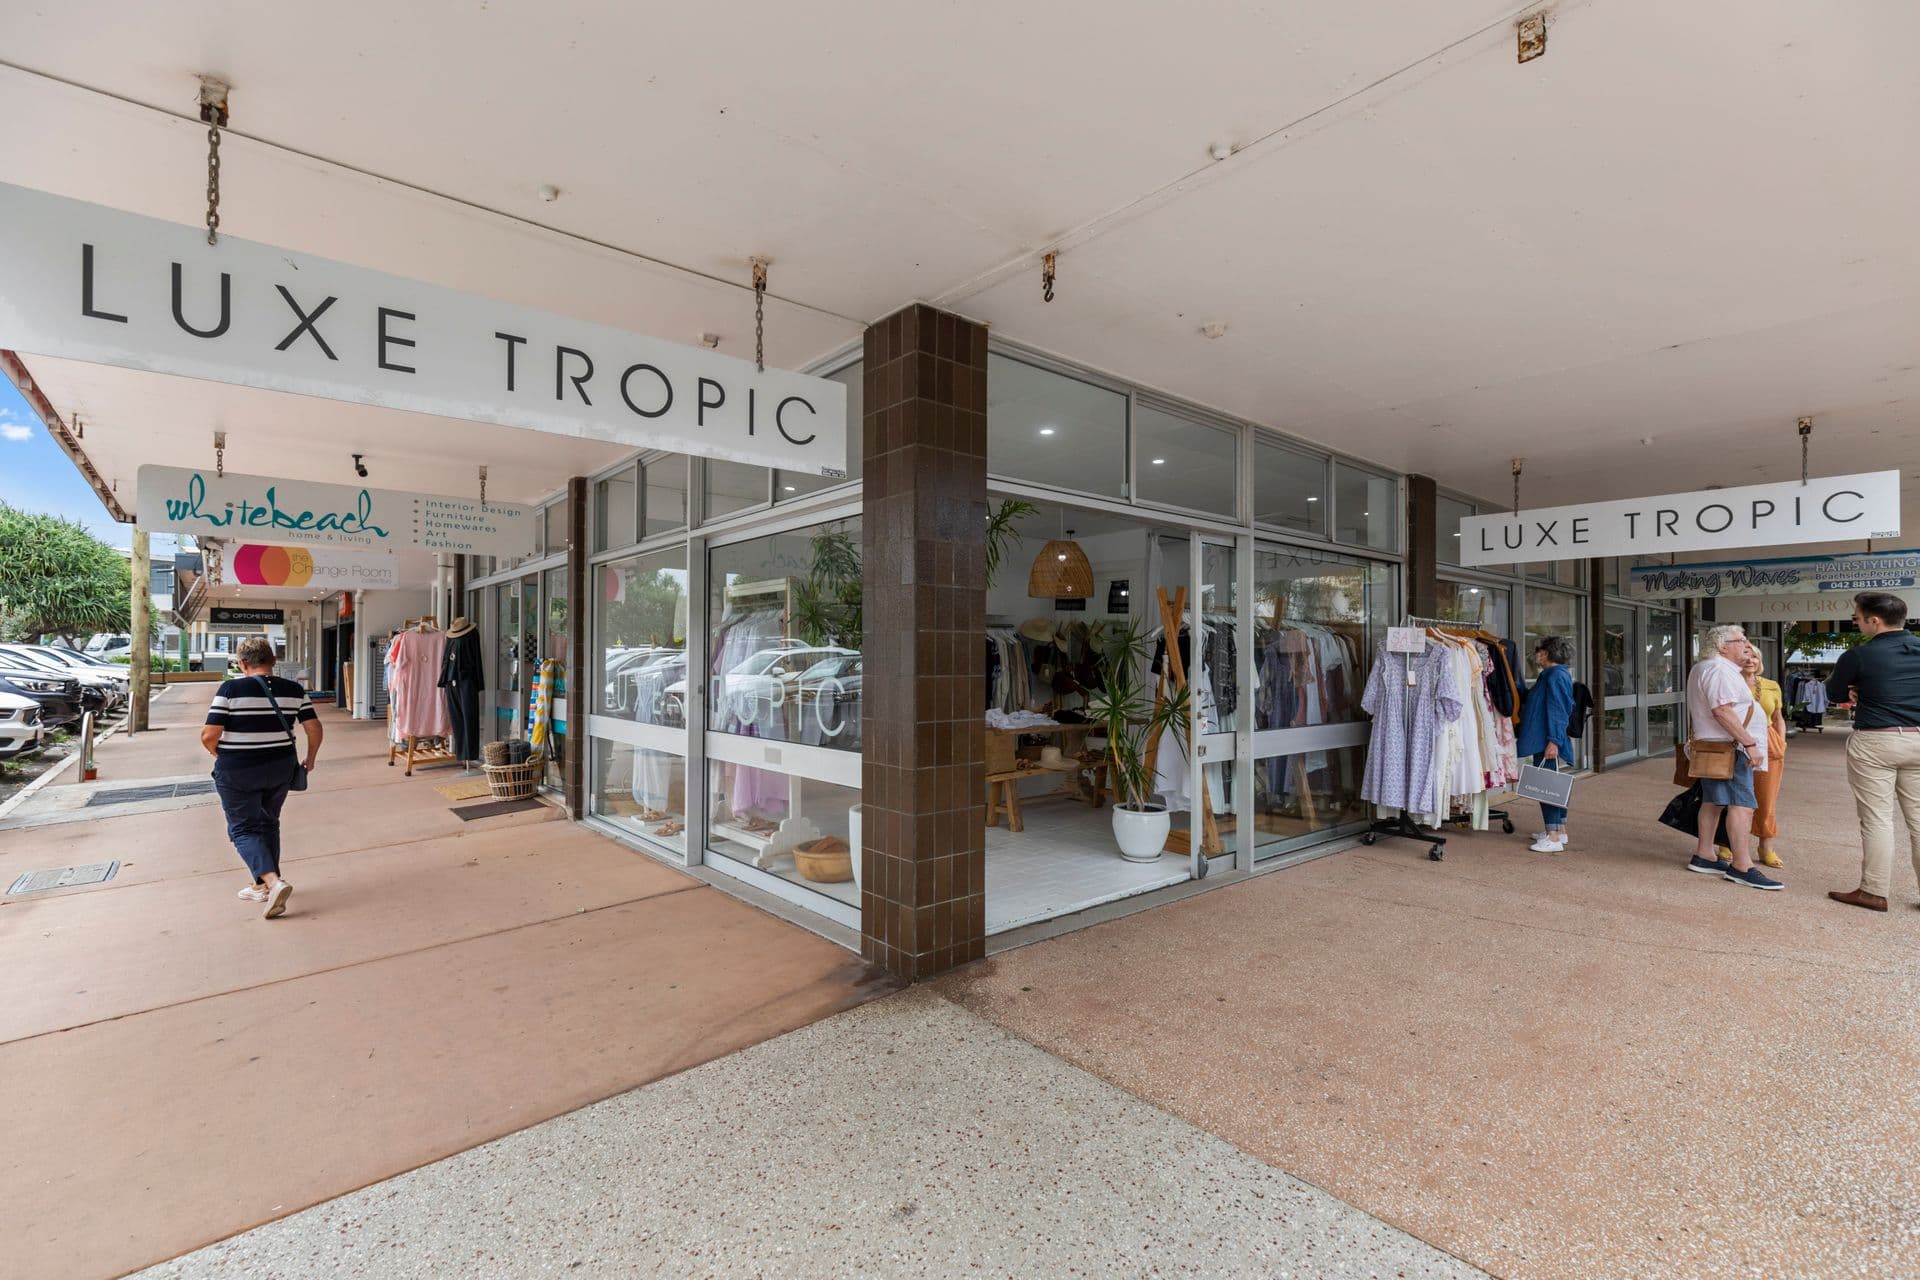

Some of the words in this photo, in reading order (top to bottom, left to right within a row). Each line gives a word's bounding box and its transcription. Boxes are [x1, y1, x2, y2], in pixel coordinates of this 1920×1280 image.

[82, 243, 416, 374] LUXE
[494, 331, 817, 445] TROPIC
[166, 473, 389, 537] whitebeach
[425, 500, 475, 511] Interior
[481, 505, 521, 517] Design
[425, 510, 485, 522] Furniture
[1481, 517, 1590, 551] LUXE
[1624, 490, 1866, 539] TROPIC
[425, 520, 497, 533] Homewares
[288, 531, 321, 540] home
[327, 533, 334, 541] &
[339, 534, 372, 545] living
[426, 530, 447, 538] Art
[425, 539, 472, 549] Fashion
[292, 553, 309, 562] the
[291, 561, 348, 578] Change
[352, 565, 392, 578] Room
[1815, 557, 1917, 572] HAIRSTYLING
[1641, 570, 1721, 597] Making
[1725, 565, 1801, 589] Waves
[1830, 581, 1850, 589] 042
[1852, 580, 1878, 588] 8811
[1881, 579, 1901, 587] 502
[1807, 599, 1856, 612] BRO
[232, 612, 277, 620] OPTOMETRIST
